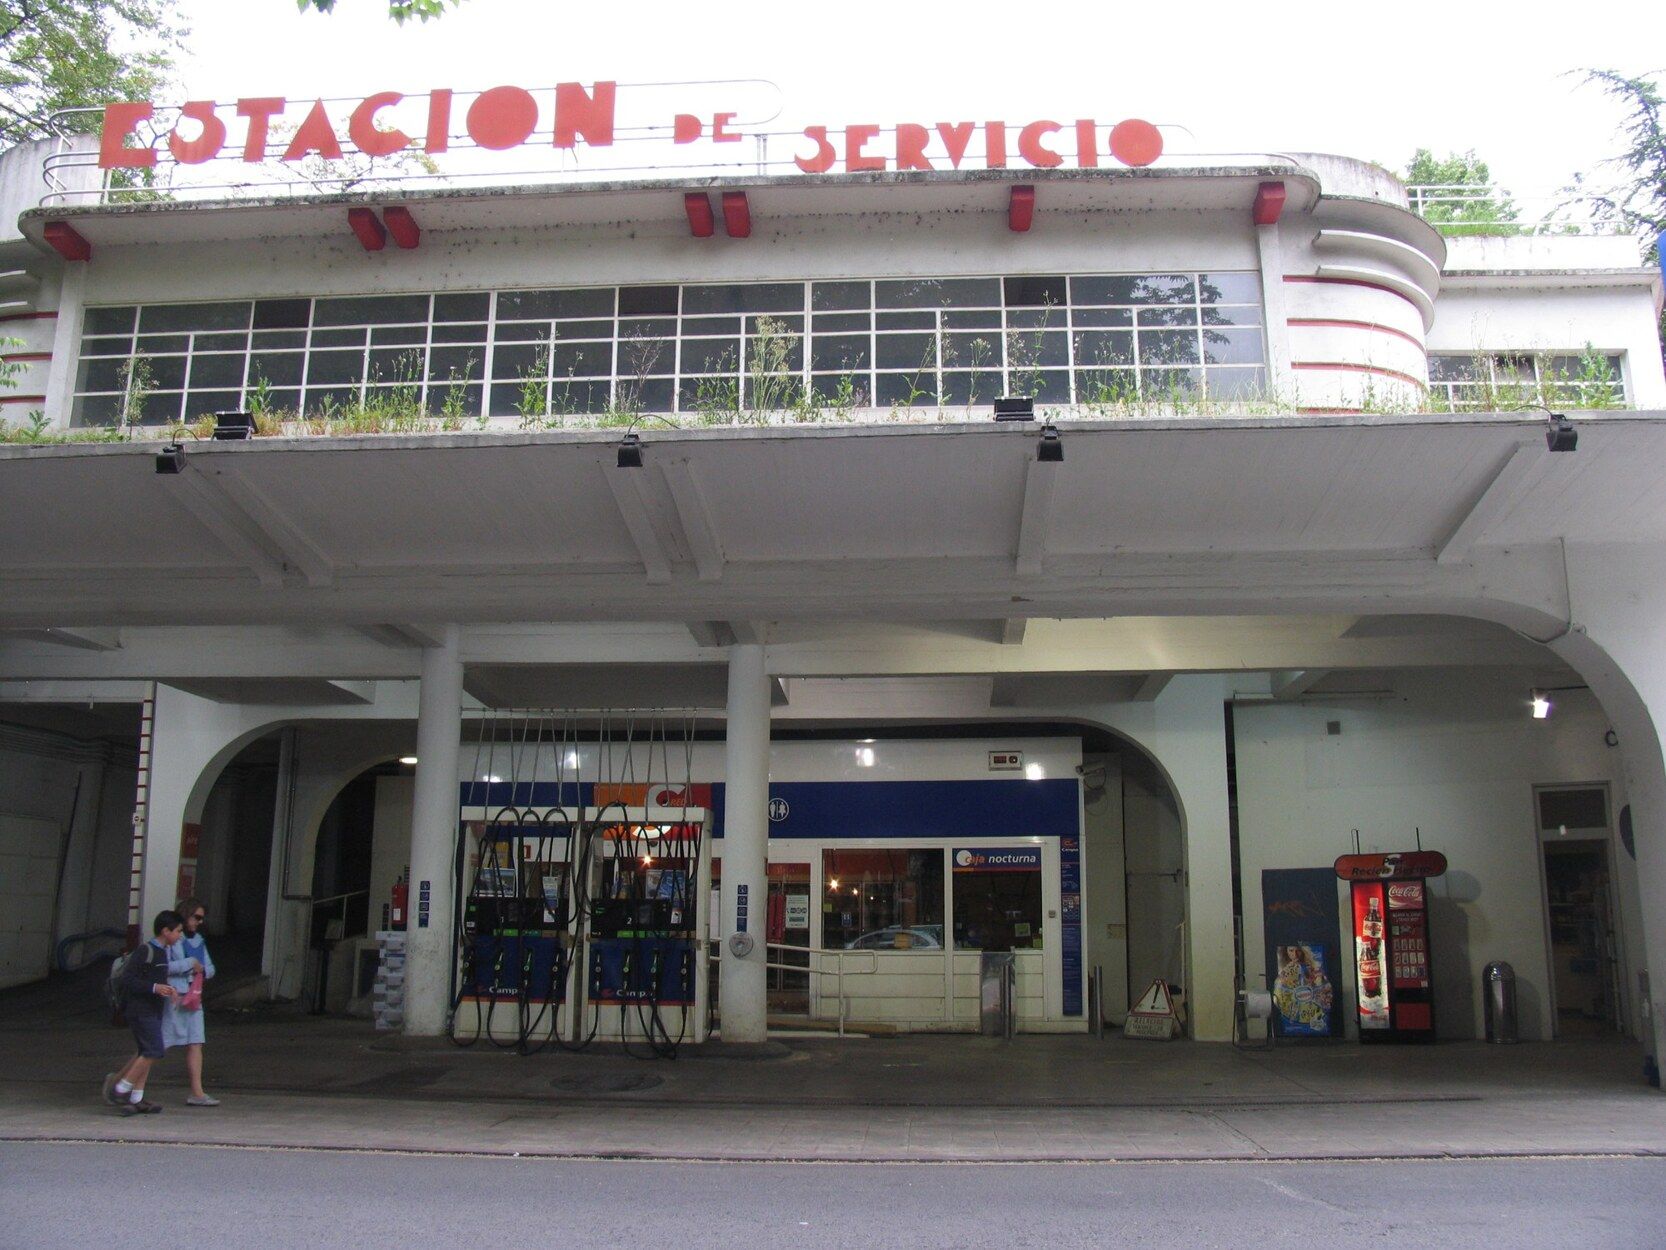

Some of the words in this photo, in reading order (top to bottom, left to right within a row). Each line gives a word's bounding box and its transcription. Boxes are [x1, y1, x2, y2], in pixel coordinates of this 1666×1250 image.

[98, 81, 616, 169] ESTACION
[674, 112, 742, 144] DE
[794, 118, 1164, 173] SERVICIO
[988, 854, 1036, 864] nocturna
[627, 916, 633, 925] 2
